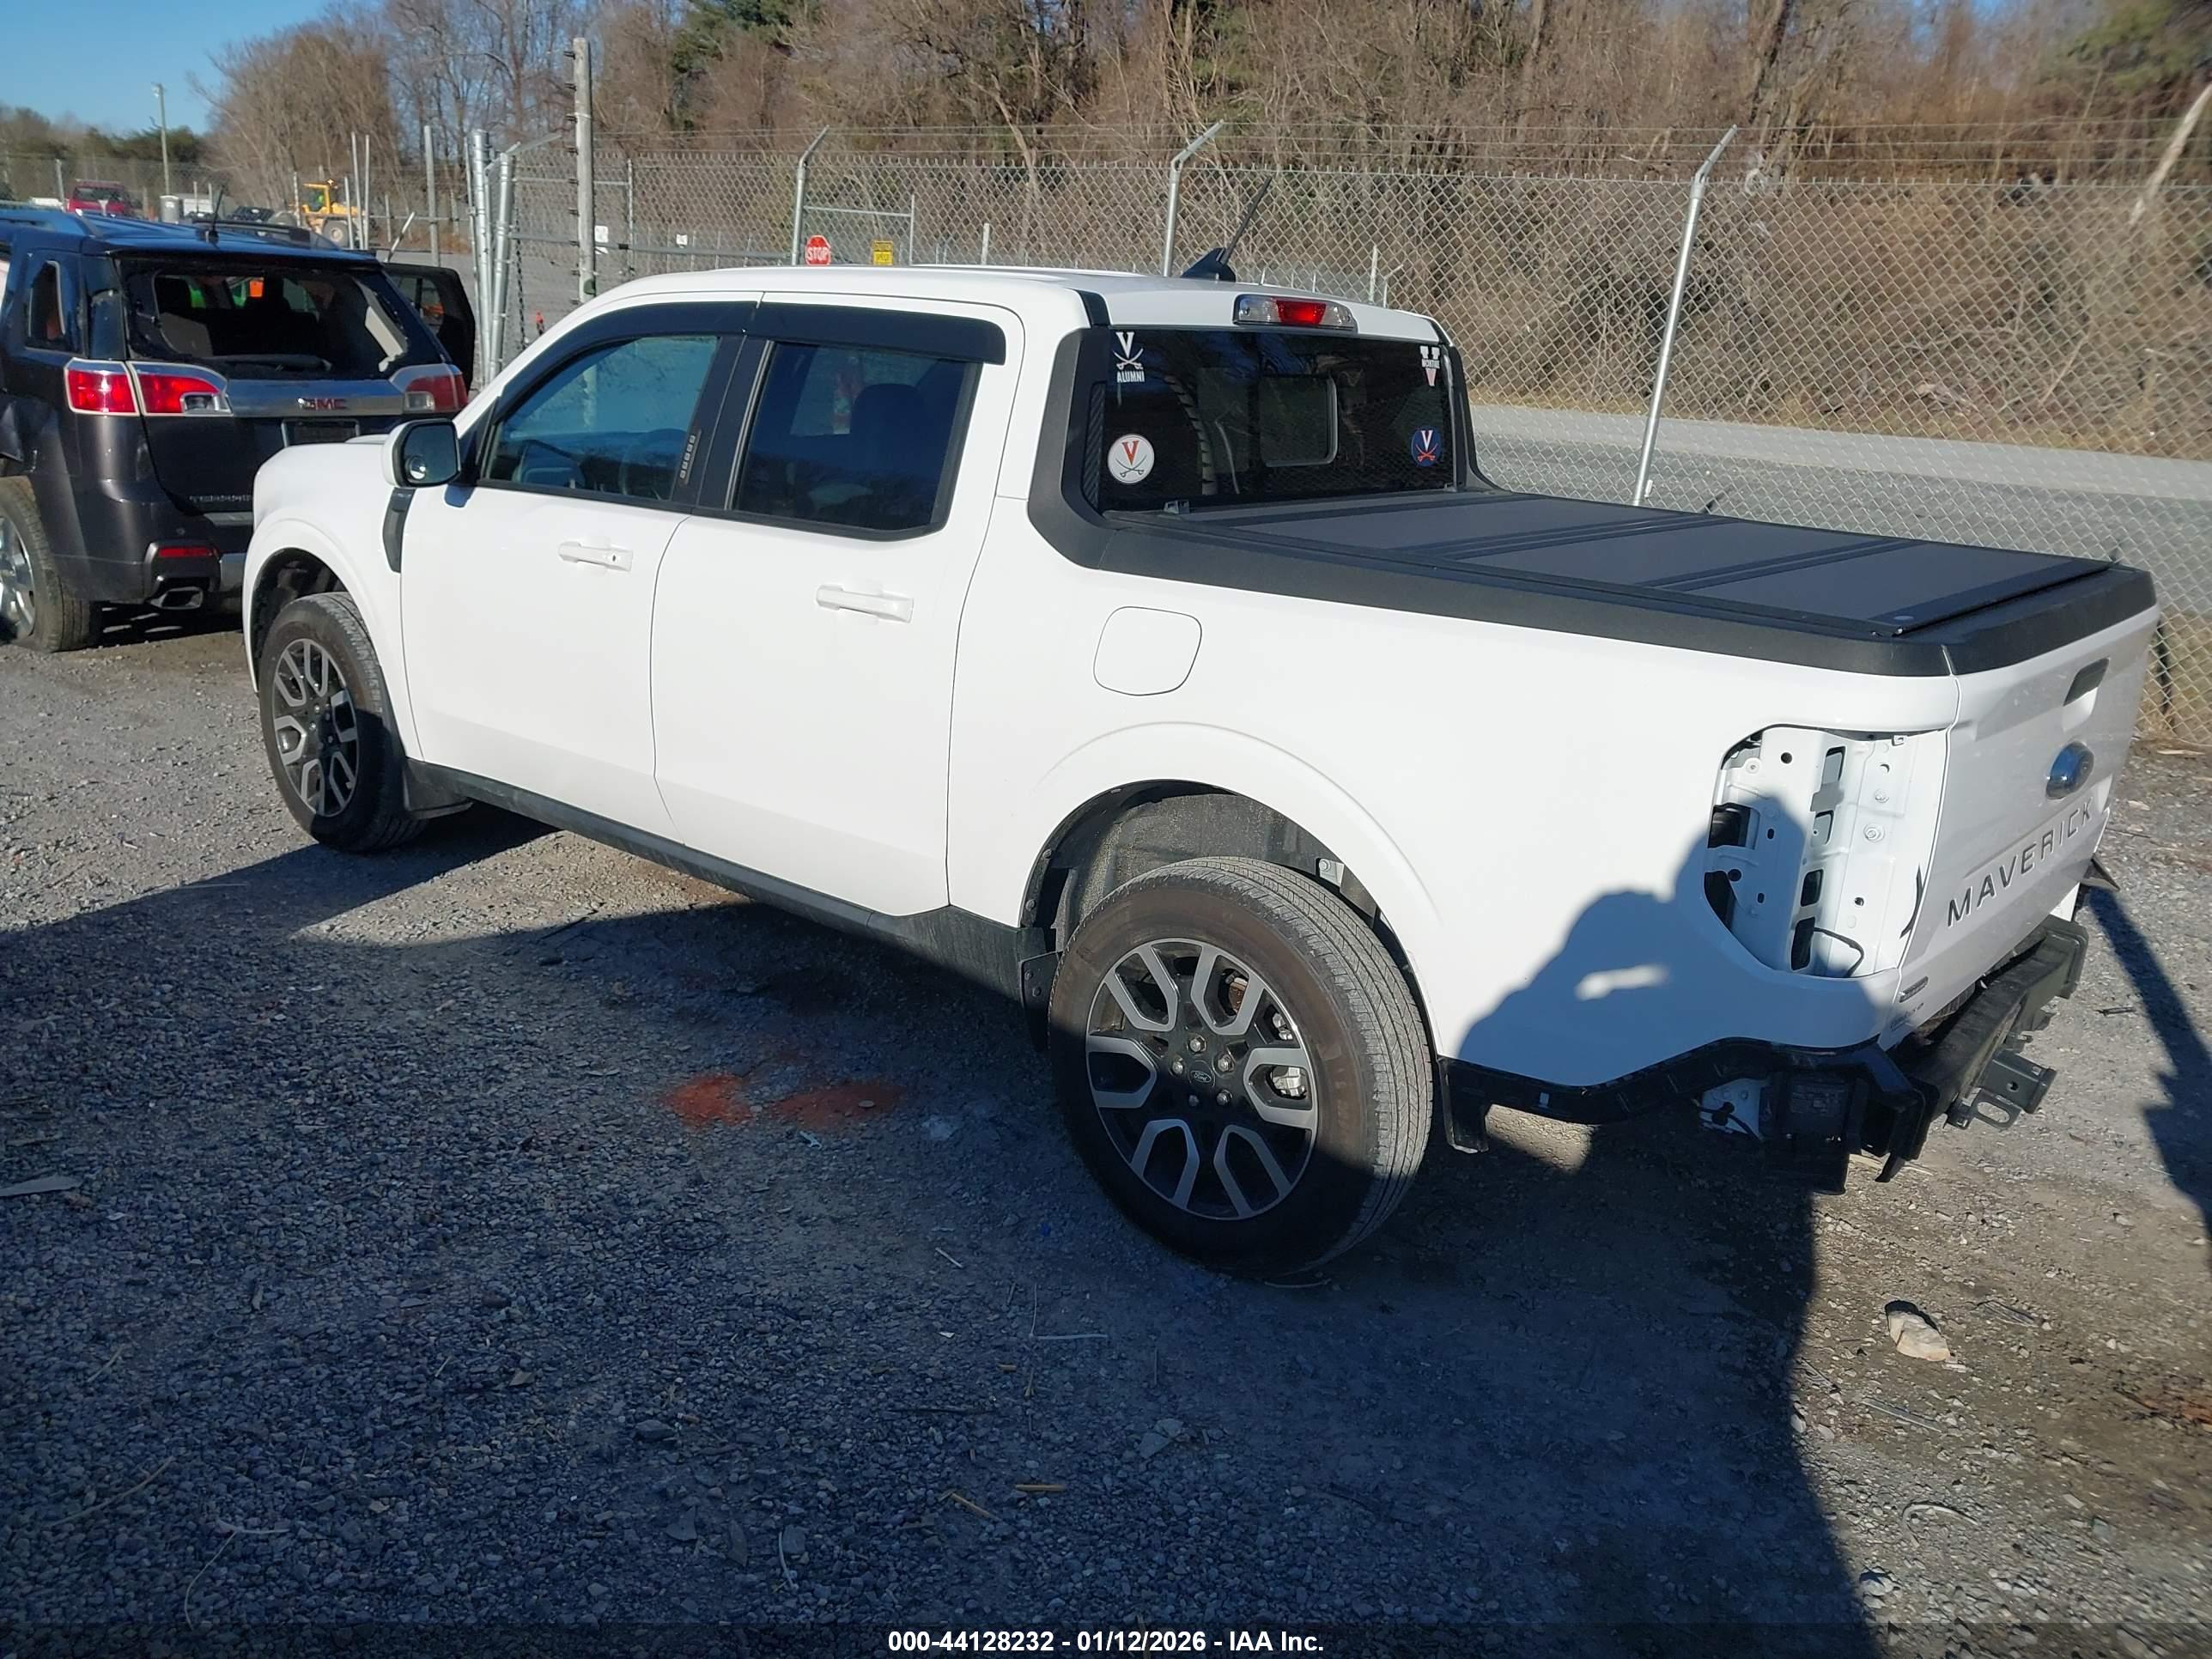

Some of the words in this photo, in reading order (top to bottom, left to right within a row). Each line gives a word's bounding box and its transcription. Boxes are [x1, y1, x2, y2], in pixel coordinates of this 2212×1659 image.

[807, 246, 830, 261] STOP
[1116, 370, 1146, 383] ALUMNI
[297, 398, 347, 410] GMC
[1948, 797, 2094, 927] MAVERICK
